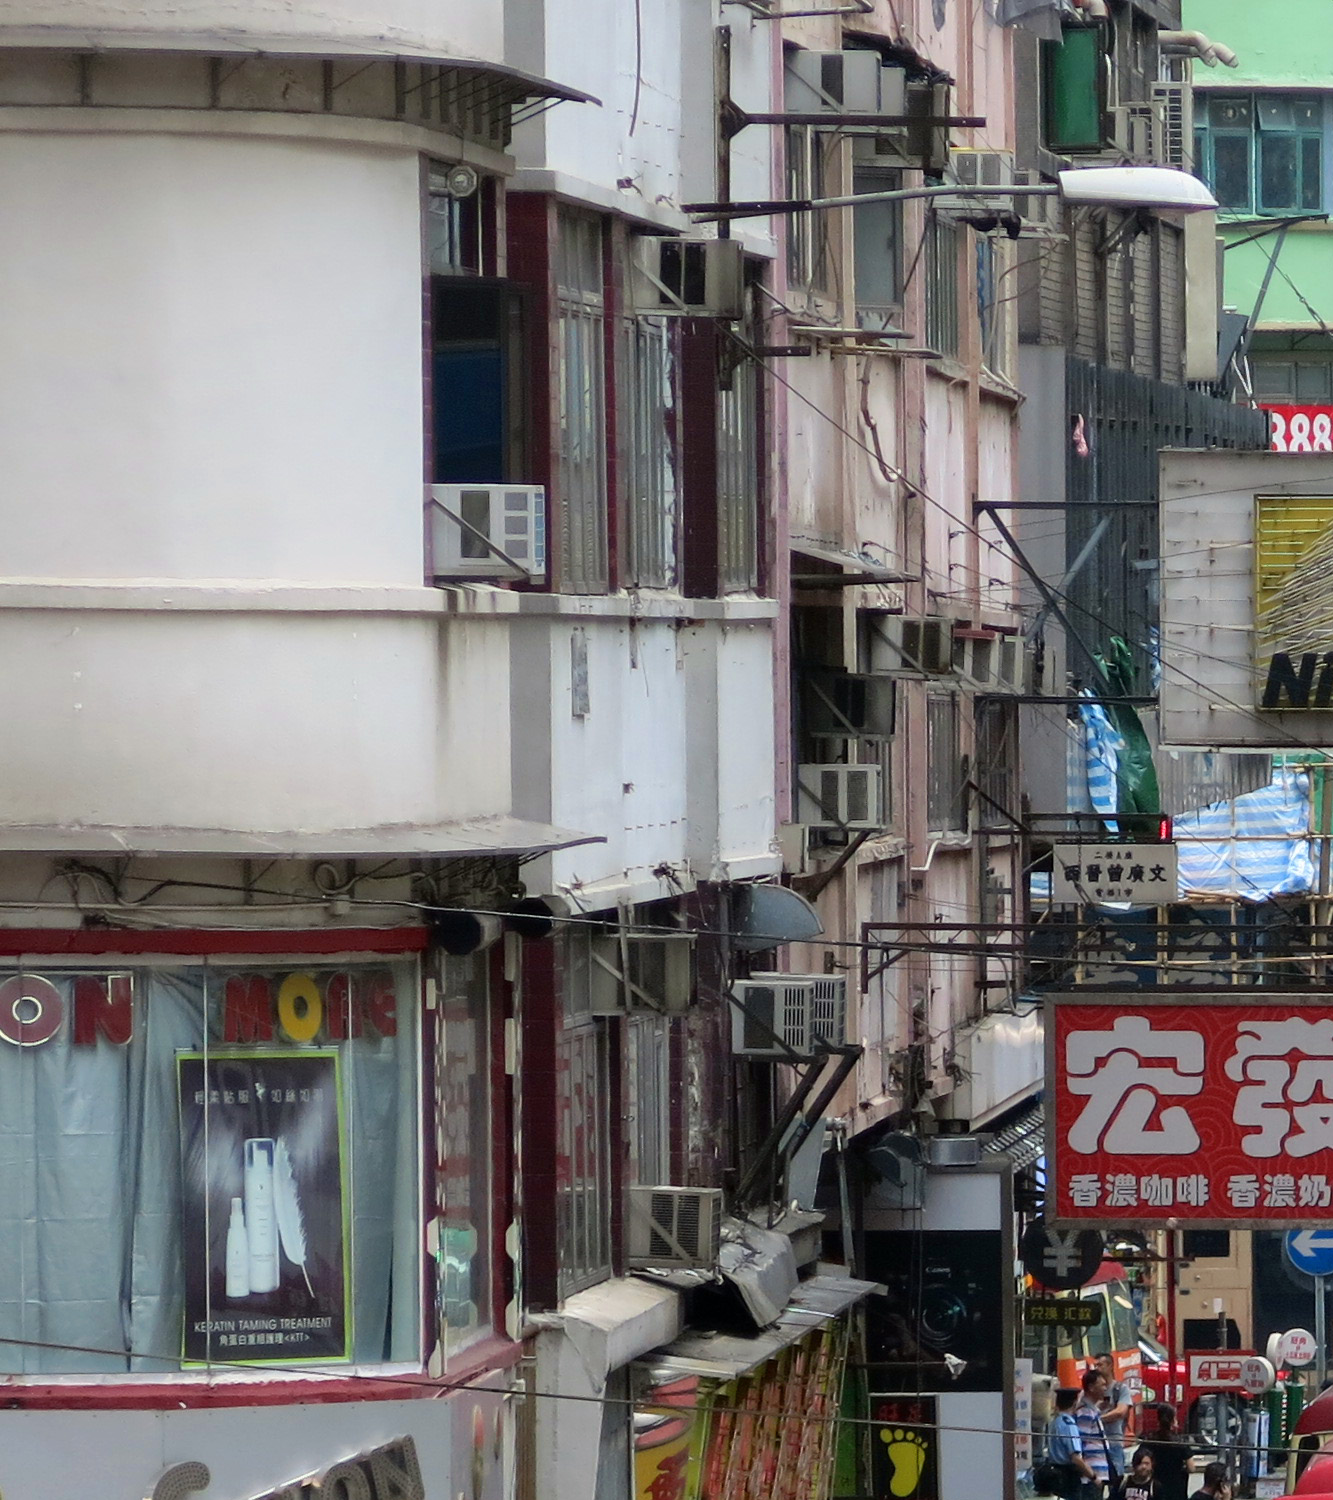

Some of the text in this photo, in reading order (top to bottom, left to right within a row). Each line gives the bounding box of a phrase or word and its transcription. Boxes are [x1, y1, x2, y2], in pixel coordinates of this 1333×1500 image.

[1069, 1174, 1210, 1209] 香濃咖啡
[194, 1317, 332, 1333] KERATIN TAMING TREATMENT
